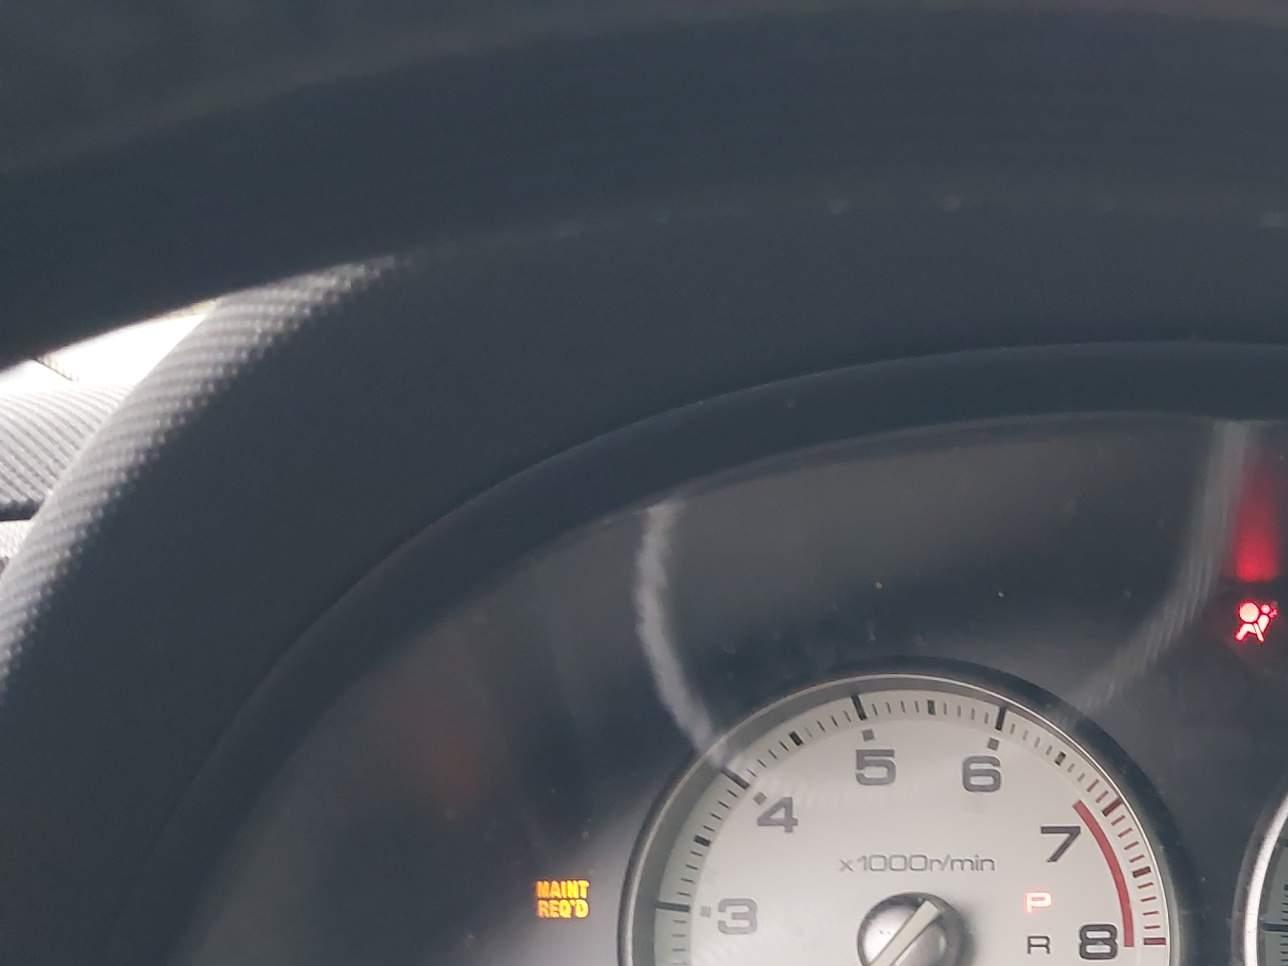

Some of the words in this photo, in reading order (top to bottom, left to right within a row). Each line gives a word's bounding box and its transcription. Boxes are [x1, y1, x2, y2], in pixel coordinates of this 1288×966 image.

[855, 749, 896, 786] 5
[962, 755, 1002, 793] 6
[757, 797, 798, 833] 4
[1040, 826, 1081, 862] 7
[839, 854, 996, 873] x1000r/min
[536, 880, 590, 900] MAINT
[1024, 892, 1051, 912] P
[537, 900, 590, 918] REQ'D
[717, 898, 758, 934] 3
[1027, 935, 1051, 955] R
[1079, 924, 1118, 961] 8
